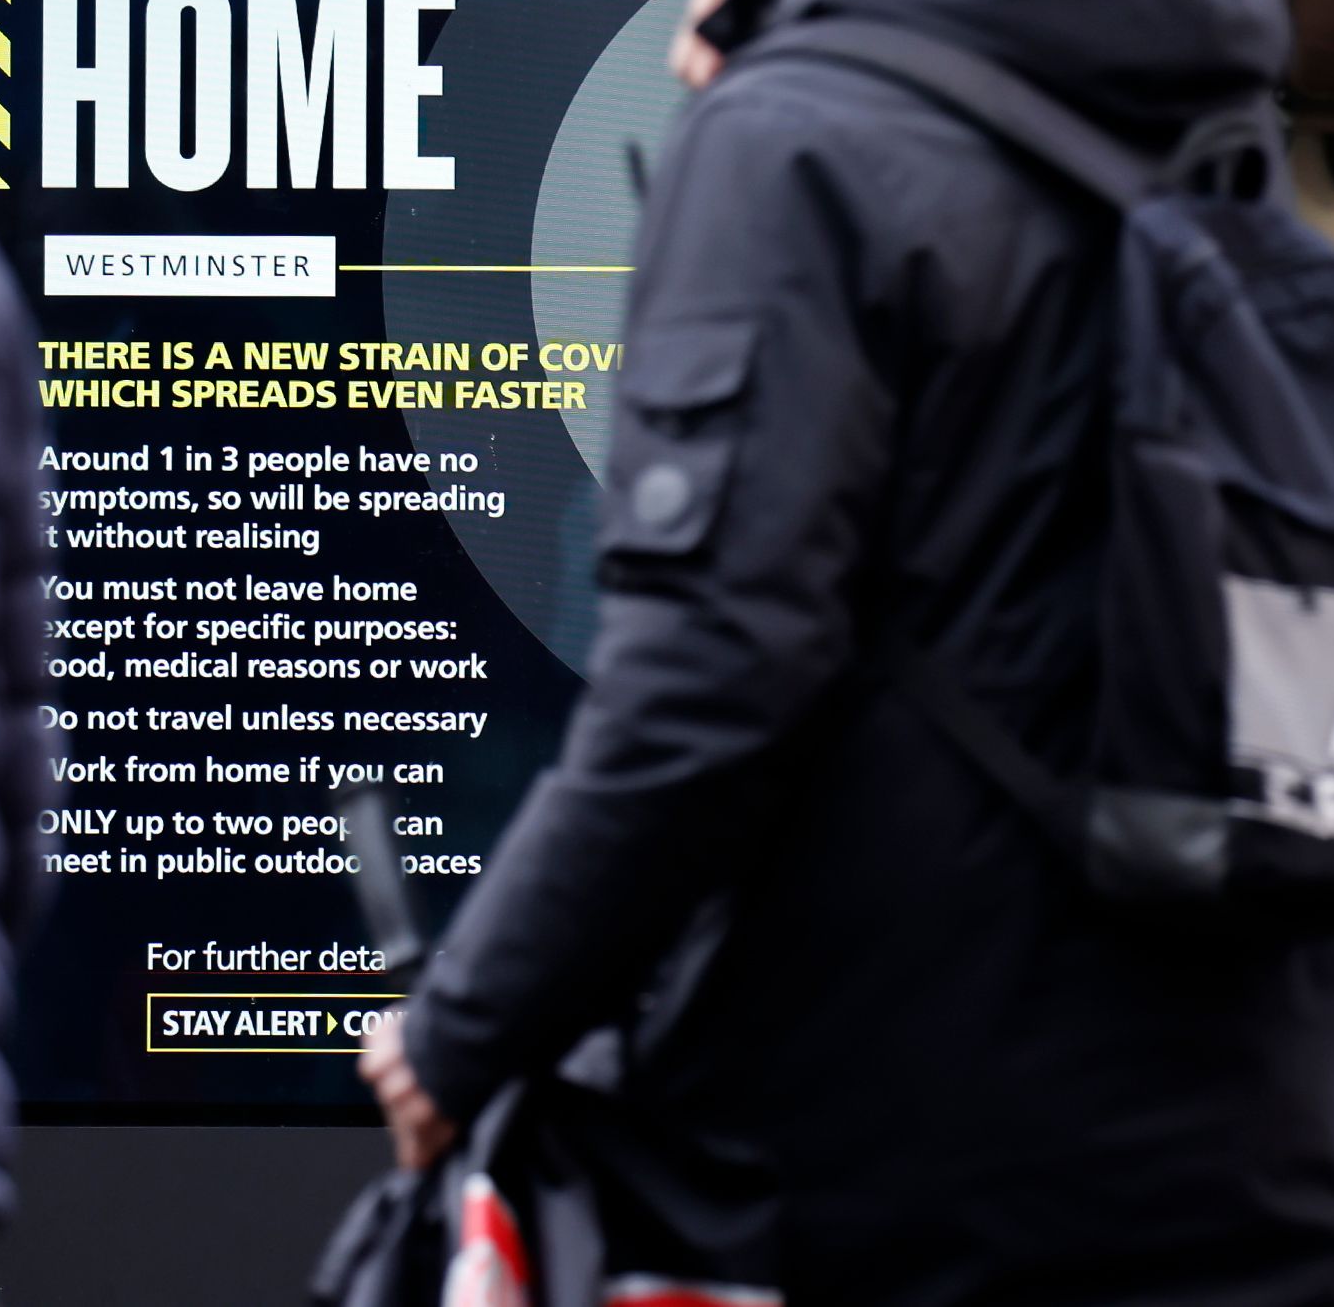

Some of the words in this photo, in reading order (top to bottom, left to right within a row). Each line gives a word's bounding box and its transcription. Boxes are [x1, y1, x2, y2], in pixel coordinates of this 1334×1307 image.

[67, 255, 309, 276] WESTMINSTER
[39, 342, 149, 369] THERE
[163, 342, 193, 369] IS
[205, 343, 232, 369] A
[245, 343, 328, 369] NEW
[340, 343, 469, 370] STRAIN
[482, 343, 528, 370] OF
[539, 343, 625, 371] COVI
[39, 380, 159, 407] WHICH
[173, 380, 336, 408] SPREADS
[349, 382, 442, 408] EVEN
[456, 382, 586, 409] FASTER
[38, 445, 148, 470] Around
[161, 447, 172, 470] 1
[187, 446, 211, 471] in
[222, 447, 238, 471] 3
[249, 445, 349, 477] people
[360, 446, 430, 471] have
[441, 453, 478, 472] no
[39, 487, 198, 516] symptoms,
[208, 491, 241, 509] so
[250, 484, 303, 509] will
[315, 484, 350, 510] be
[359, 485, 504, 517] spreading
[67, 522, 186, 548] without
[196, 523, 319, 555] realising
[42, 576, 92, 600] You
[104, 578, 177, 600] must
[187, 578, 236, 600] not
[247, 575, 323, 600] leave
[334, 575, 417, 601] home
[143, 612, 188, 639] for
[197, 613, 305, 645] specific
[315, 621, 456, 647] purposes:
[126, 652, 237, 677] medical
[248, 659, 360, 678] reasons
[370, 660, 401, 678] or
[410, 653, 487, 678] work
[88, 708, 138, 730] not
[146, 704, 231, 730] travel
[243, 704, 334, 730] unless
[345, 712, 487, 738] necessary
[125, 756, 195, 782] from
[207, 756, 289, 782] home
[300, 756, 320, 782] if
[328, 761, 383, 789] you
[394, 764, 443, 783] can
[41, 810, 116, 834] ONLY
[127, 816, 164, 841] up
[173, 812, 204, 834] to
[213, 812, 272, 834] two
[395, 817, 442, 835] can
[121, 848, 146, 872] in
[158, 847, 246, 879] public
[255, 848, 361, 873] outdoo
[400, 854, 482, 881] paces
[148, 944, 195, 970] For
[203, 941, 311, 970] further
[319, 942, 386, 971] deta
[163, 1011, 230, 1035] STAY
[234, 1011, 321, 1035] ALERT
